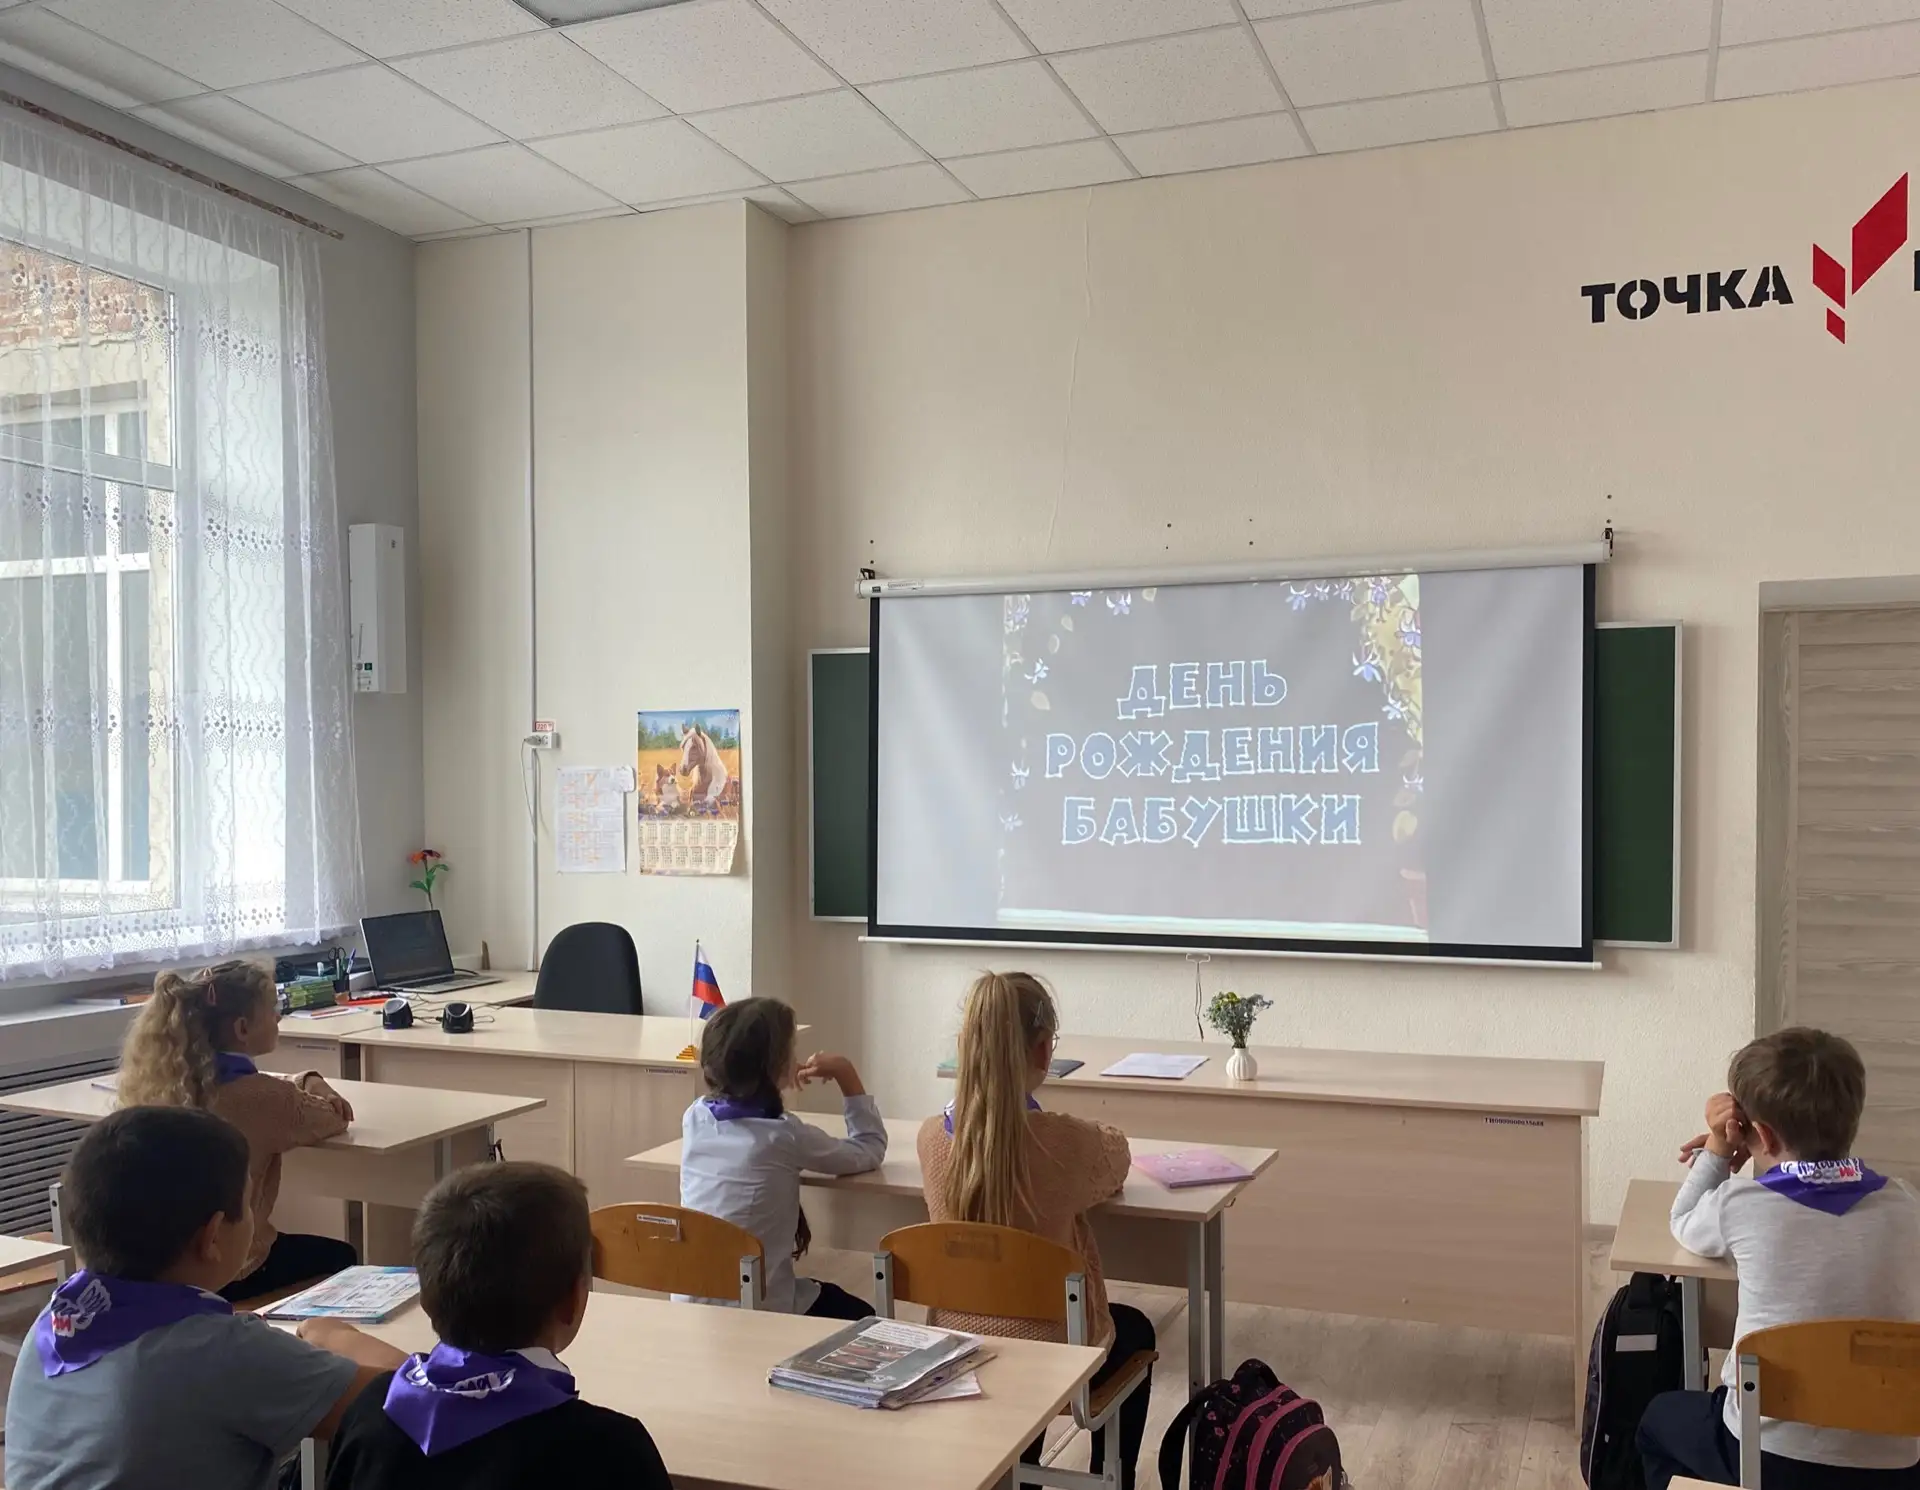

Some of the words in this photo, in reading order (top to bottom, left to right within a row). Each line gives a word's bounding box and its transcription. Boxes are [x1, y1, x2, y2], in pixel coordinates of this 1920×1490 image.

[1581, 265, 1793, 323] ТОЧКА
[1116, 659, 1287, 719] ДЕНЬ
[1045, 722, 1380, 782] РОЖДЕНИЯ
[1061, 793, 1362, 848] БАБУШКИ
